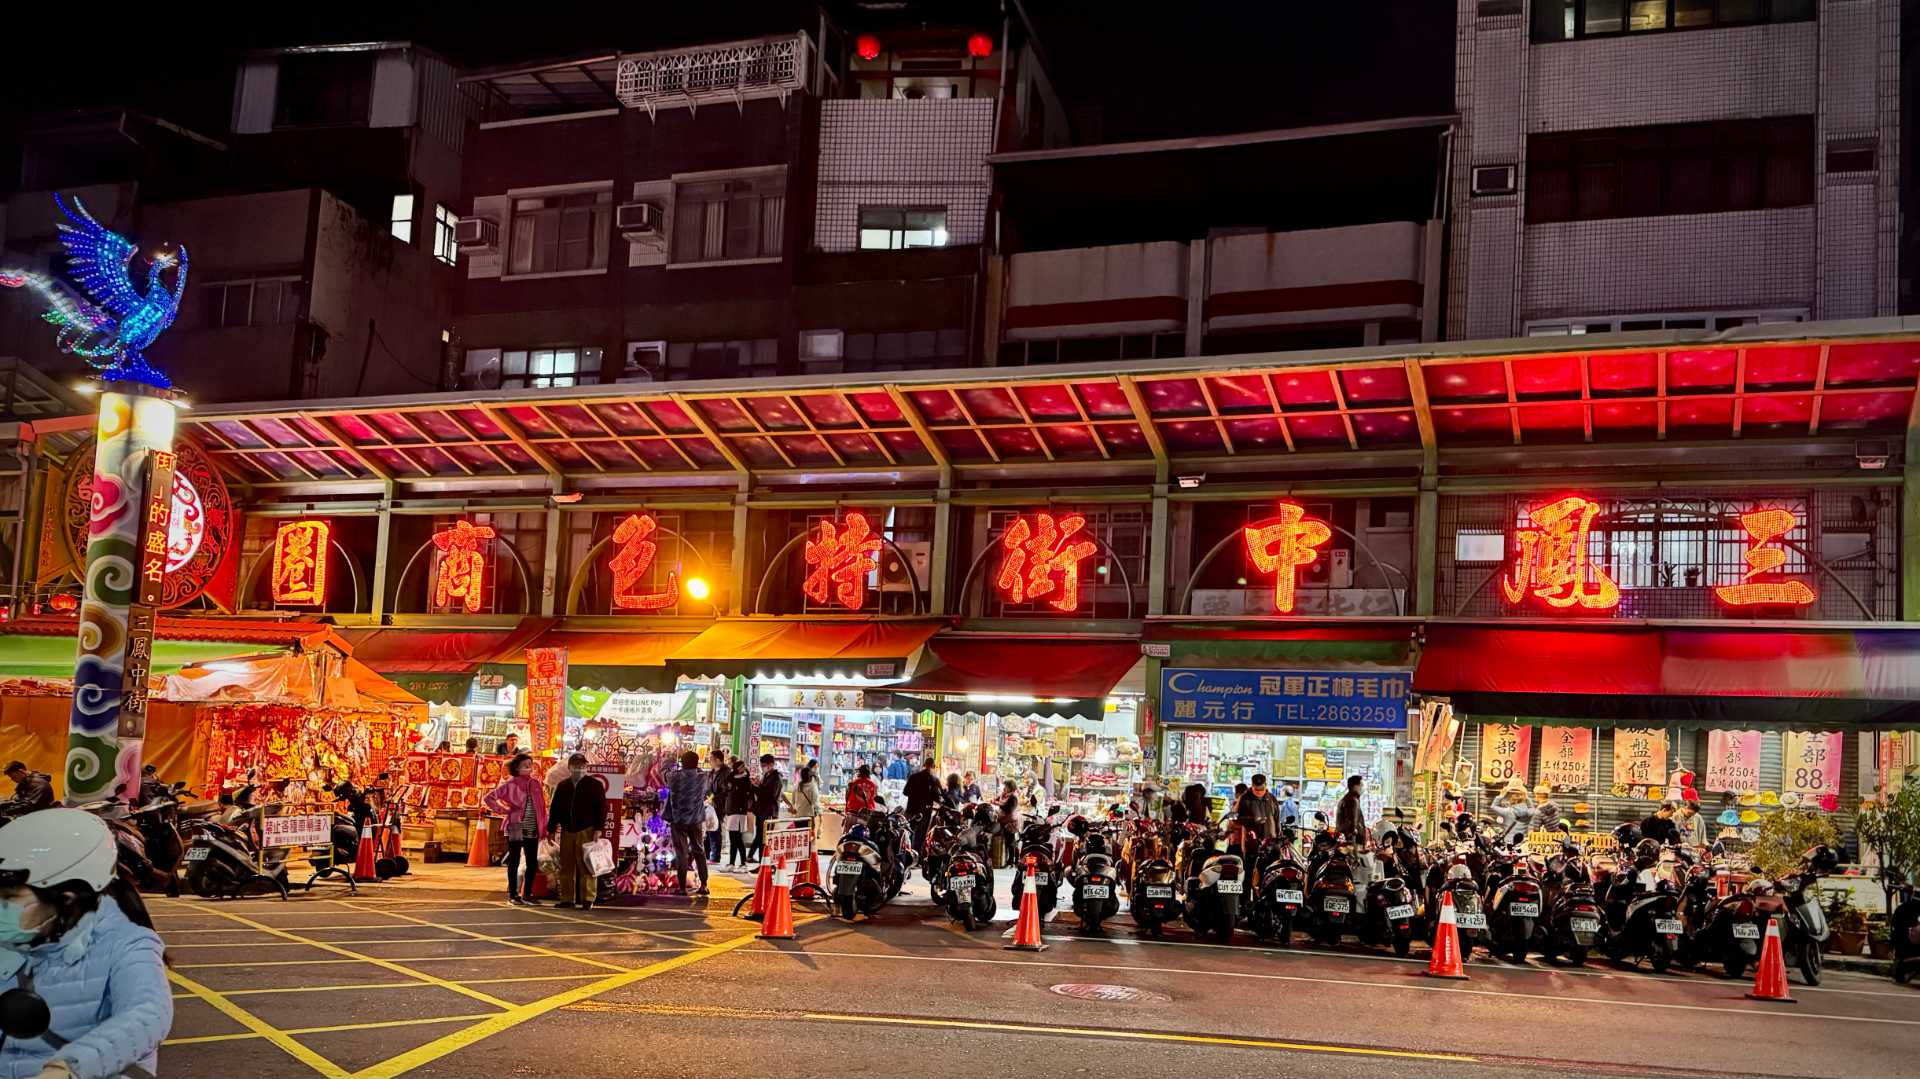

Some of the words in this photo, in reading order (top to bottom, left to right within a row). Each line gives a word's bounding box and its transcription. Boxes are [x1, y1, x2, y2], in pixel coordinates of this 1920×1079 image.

[126, 615, 151, 712] 三鳳中街
[1168, 672, 1253, 699] Champion
[1259, 676, 1404, 699] 冠軍正棉毛巾
[1174, 699, 1255, 719] 麗元行
[1275, 704, 1397, 723] TEL:2863259
[1559, 730, 1575, 759] 全部
[1726, 735, 1745, 764] 全部
